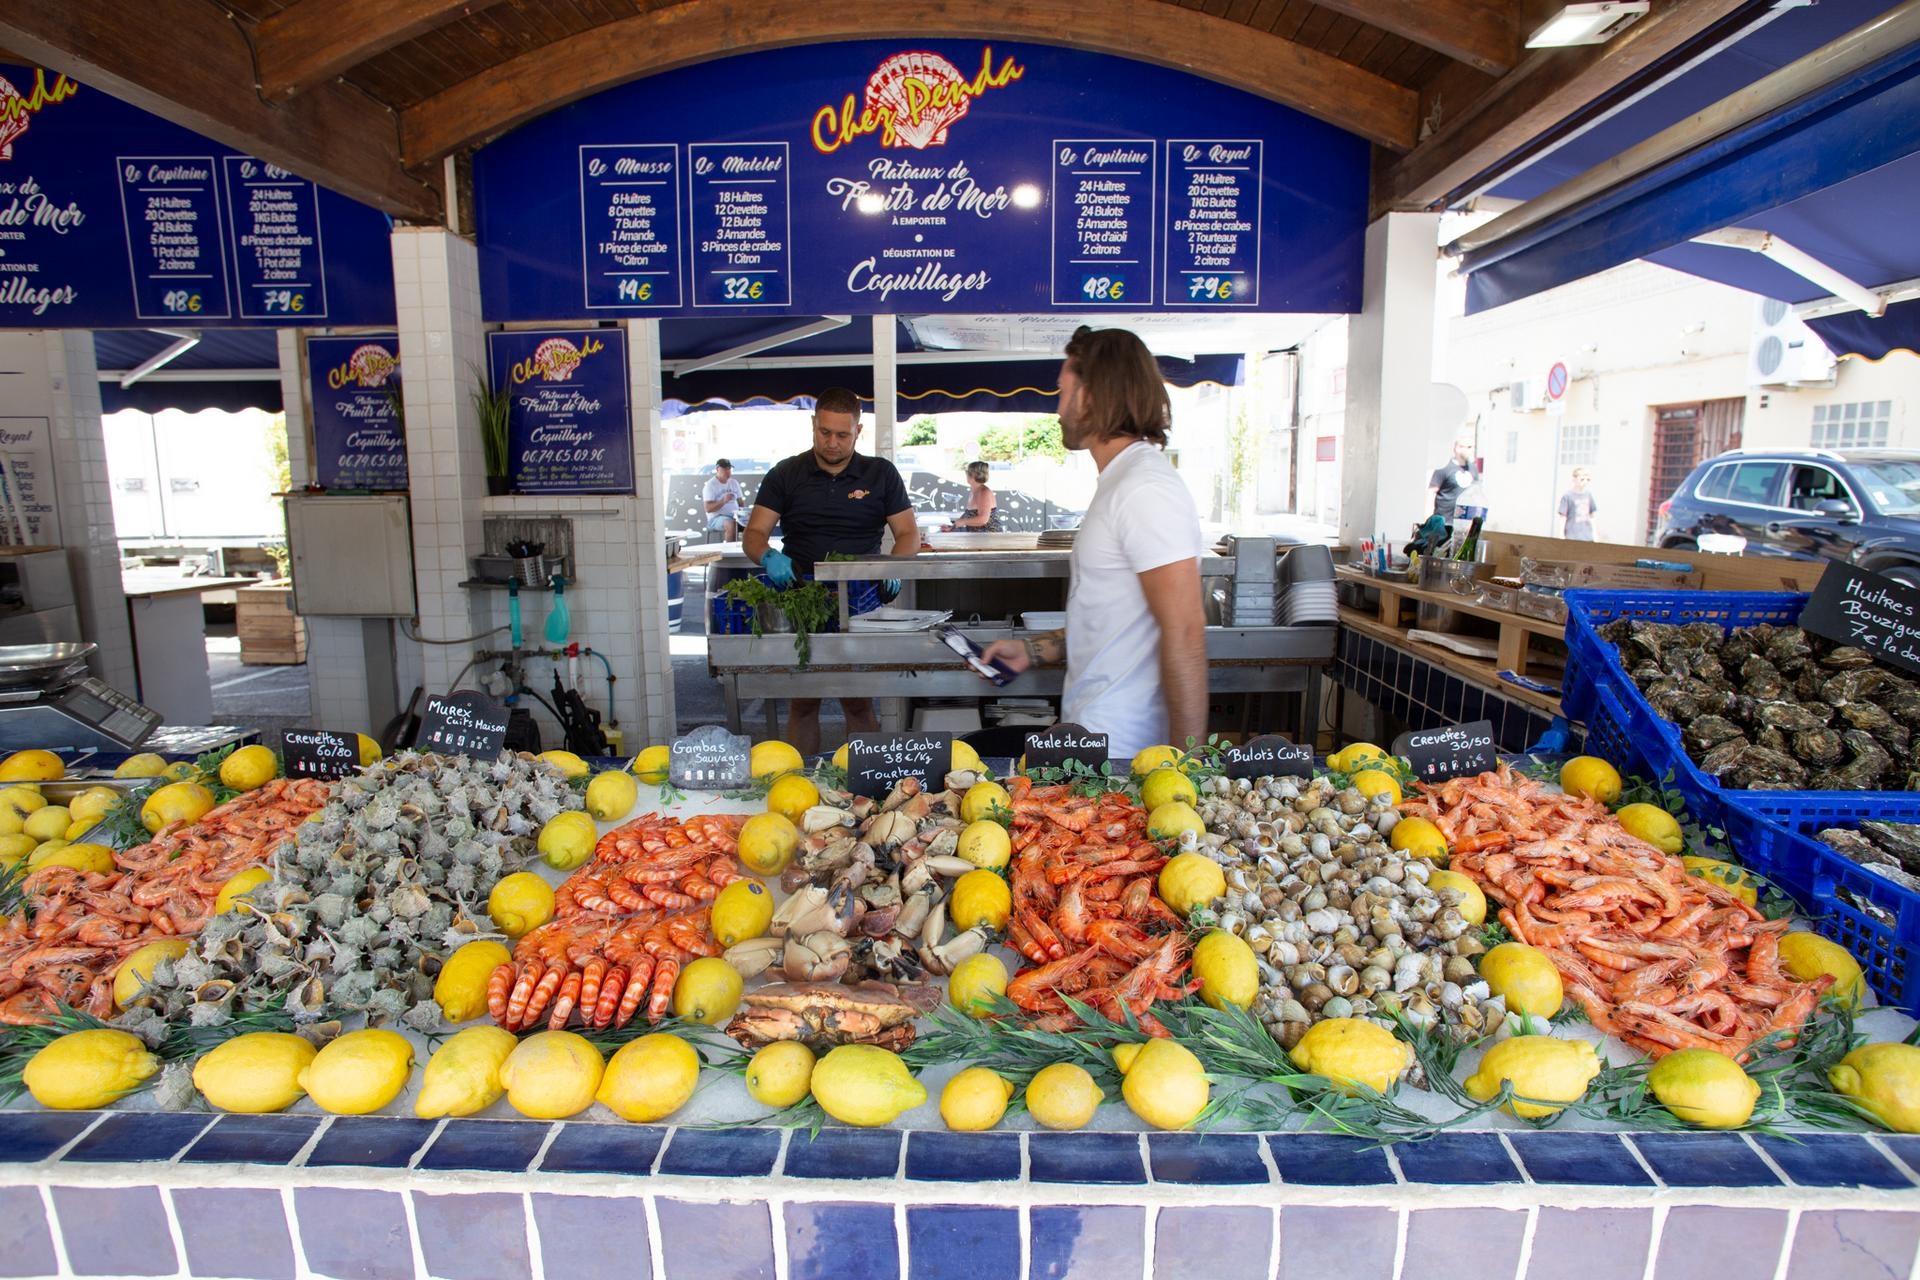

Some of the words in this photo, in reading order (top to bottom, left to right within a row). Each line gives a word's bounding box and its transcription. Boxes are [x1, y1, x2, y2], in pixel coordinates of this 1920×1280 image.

[811, 93, 899, 152] Chez
[903, 47, 1025, 126] Penda
[1060, 147, 1078, 166] Le
[1084, 147, 1149, 167] Capitaine
[1183, 145, 1201, 162] Le
[1209, 144, 1251, 164] Royal
[240, 161, 258, 179] Le
[588, 158, 608, 177] Le
[614, 158, 672, 175] Mousse
[695, 157, 715, 175] Le
[722, 156, 782, 173] Matelot
[868, 157, 946, 180] Plateaux
[947, 160, 969, 180] de
[125, 165, 142, 183] Le
[148, 165, 209, 184] Capitaine
[1192, 174, 1204, 184] 24
[1205, 174, 1236, 184] Huîtres
[20, 176, 40, 195] de
[1079, 181, 1092, 191] 24
[1093, 180, 1126, 191] Huîtres
[1188, 186, 1200, 196] 20
[1200, 186, 1240, 196] Crevettes
[612, 193, 620, 204] 6
[620, 192, 651, 204] Huîtres
[719, 192, 730, 202] 18
[731, 191, 762, 202] Huîtres
[921, 182, 952, 211] de
[950, 177, 1011, 219] Mer
[1075, 193, 1087, 204] 20
[1088, 193, 1130, 204] Crevettes
[1191, 198, 1208, 208] 1KG
[1209, 197, 1237, 208] Bulots
[25, 194, 86, 234] Mer
[608, 206, 615, 217] 8
[616, 206, 656, 217] Crevettes
[714, 204, 726, 215] 12
[727, 204, 767, 215] Crevettes
[1081, 206, 1094, 216] 24
[1095, 206, 1123, 216] Bulots
[1189, 209, 1196, 219] 8
[1197, 209, 1237, 219] Amandes
[615, 219, 622, 229] 7
[622, 218, 650, 229] Bulots
[721, 217, 733, 227] 12
[733, 216, 761, 227] Bulots
[892, 216, 899, 226] À
[900, 217, 946, 226] EMPORTER
[1077, 219, 1084, 229] 5
[1084, 218, 1127, 229] Amandes
[1174, 221, 1181, 230] 8
[1181, 220, 1210, 231] Pinces
[1211, 220, 1222, 231] de
[1223, 220, 1251, 231] crabes
[618, 230, 655, 241] Amande
[717, 229, 724, 239] 3
[724, 228, 766, 239] Amandes
[1084, 231, 1100, 242] Pot
[1188, 232, 1195, 242] 2
[1196, 232, 1237, 242] Tourteaux
[606, 243, 630, 254] Pince
[631, 243, 642, 254] de
[642, 242, 668, 254] crabe
[702, 242, 709, 252] 3
[709, 241, 738, 252] Pinces
[739, 241, 751, 252] de
[751, 241, 781, 251] crabes
[883, 248, 942, 258] DÉGUSTATION
[944, 249, 956, 258] DE
[1083, 244, 1089, 254] 2
[1090, 244, 1121, 254] citrons
[1195, 244, 1211, 254] Pot
[623, 255, 648, 265] Citron
[734, 253, 761, 264] Citron
[1194, 256, 1201, 265] 2
[1201, 255, 1230, 266] citrons
[28, 262, 40, 272] DE
[847, 256, 992, 302] Coquillages
[618, 278, 652, 300] 14€
[724, 277, 763, 299] 32€
[1083, 277, 1124, 299] 48€
[1189, 277, 1233, 299] 79€
[163, 290, 202, 312] 48€
[264, 290, 304, 312] 79€
[512, 357, 551, 384] Chez
[552, 336, 604, 372] Penda
[329, 361, 363, 390] Chez
[336, 402, 374, 417] Fruits
[520, 397, 560, 412] Fruits
[561, 399, 575, 411] de
[574, 397, 602, 414] Mer
[530, 427, 594, 446] Coquillages
[1846, 578, 1914, 616] Huitres
[1849, 620, 1878, 645] 7€
[1883, 636, 1897, 654] la
[428, 700, 472, 718] Murex
[446, 716, 473, 728] Cuits
[475, 719, 506, 733] Maison
[286, 731, 344, 746] Crevettes
[1027, 733, 1061, 749] Perle
[1064, 733, 1077, 748] de
[1080, 735, 1106, 748] Corail
[1410, 730, 1467, 747] Crevettes
[1450, 737, 1491, 751] 30/50
[317, 745, 352, 757] 60/80
[673, 739, 726, 754] Gambas
[849, 739, 888, 755] Pince
[890, 738, 903, 752] de
[905, 737, 943, 751] Crabe
[695, 753, 747, 767] Sauvages
[1228, 746, 1274, 763] Bulots
[1277, 746, 1310, 760] Cuits
[860, 766, 926, 780] Tourteau
